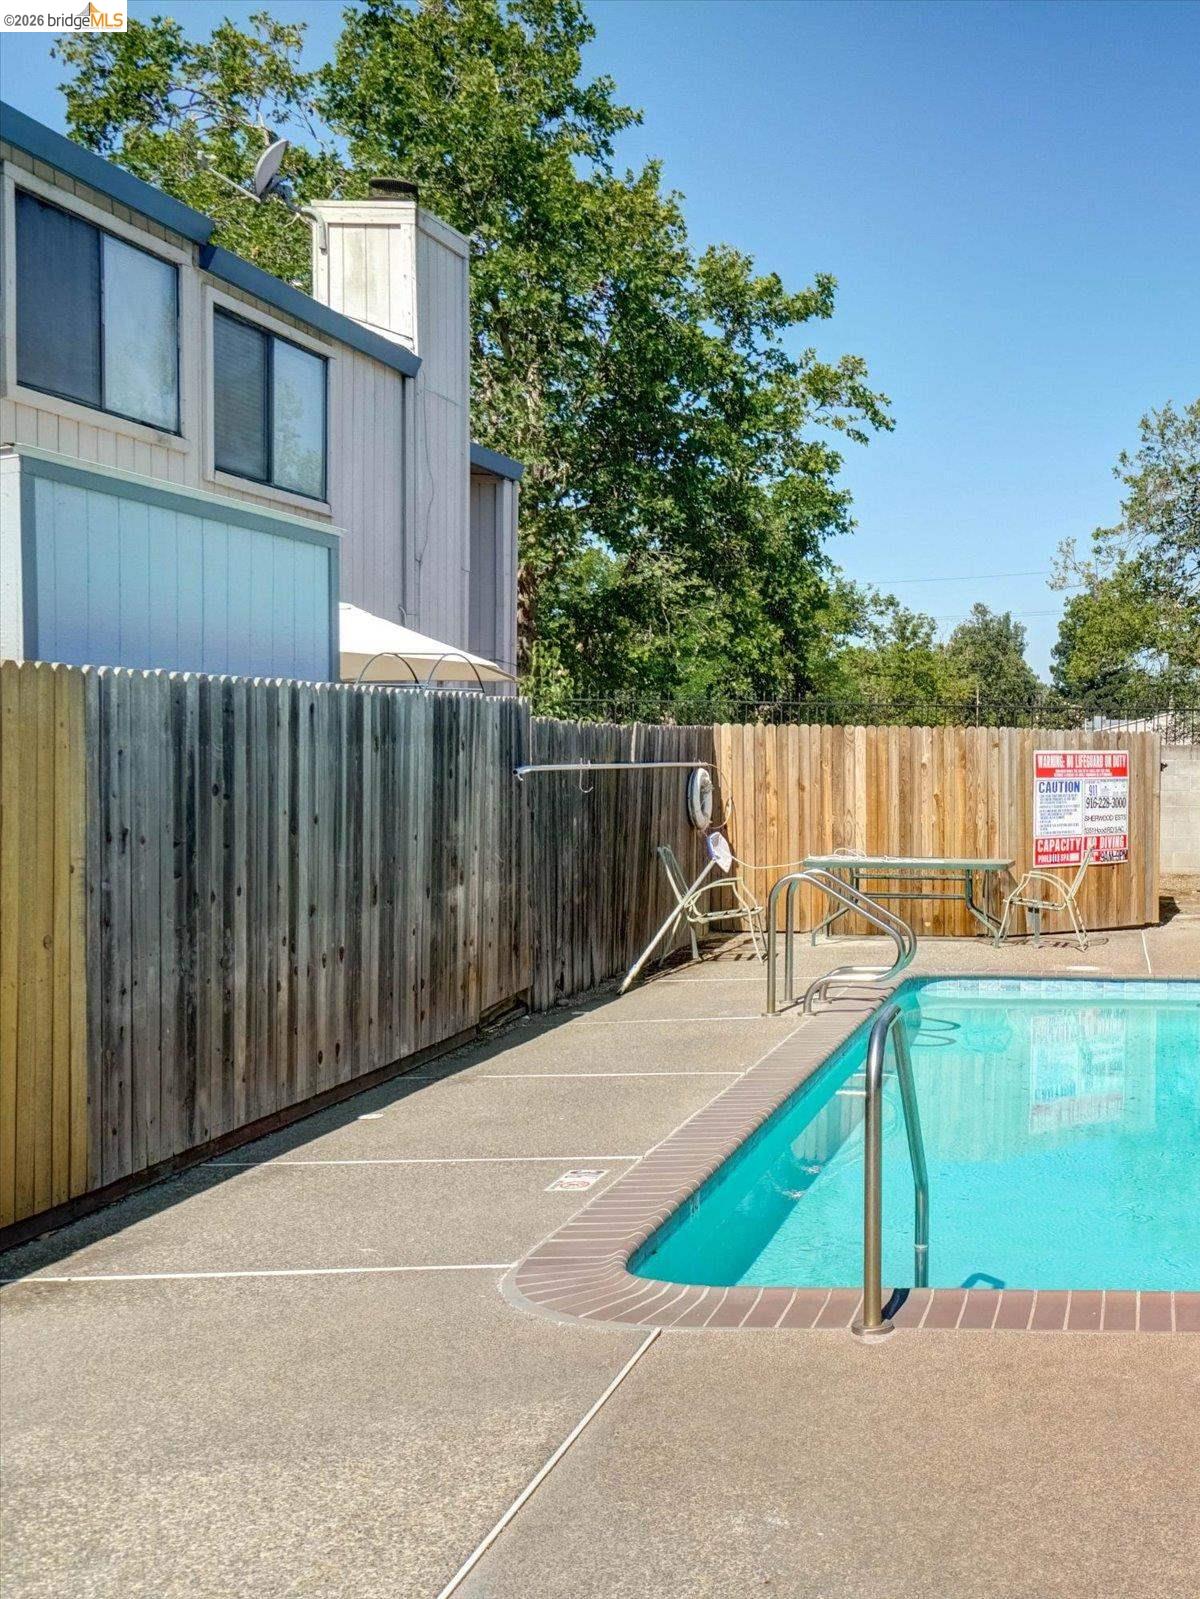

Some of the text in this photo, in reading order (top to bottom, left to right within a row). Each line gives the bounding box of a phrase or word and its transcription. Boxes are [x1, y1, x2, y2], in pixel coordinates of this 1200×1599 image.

[1066, 754, 1074, 769] NO
[1075, 754, 1104, 769] LIFEGUARD
[1104, 754, 1112, 769] ON
[1113, 754, 1127, 768] DUTY
[1038, 781, 1081, 794] CAUTION
[1088, 784, 1098, 797] 911
[1037, 837, 1081, 853] CAPACITY
[1100, 835, 1125, 849] DIVING
